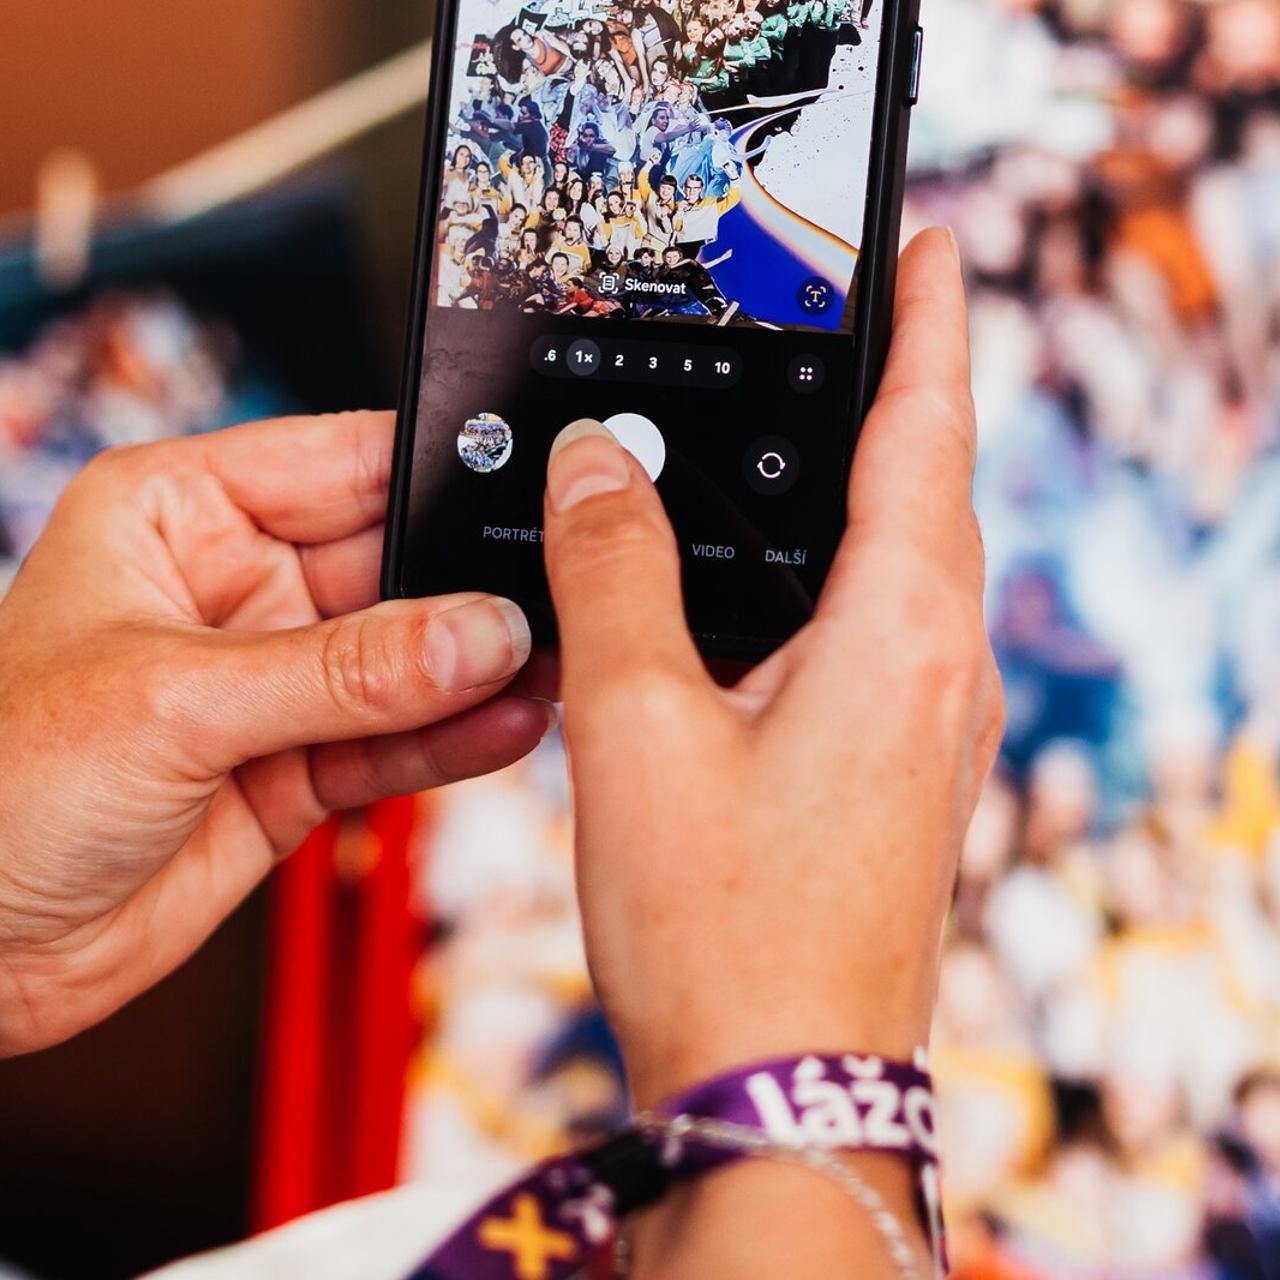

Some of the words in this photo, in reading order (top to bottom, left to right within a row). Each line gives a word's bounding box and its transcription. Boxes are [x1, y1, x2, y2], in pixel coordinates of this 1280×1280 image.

[624, 278, 686, 295] Skenovat
[544, 349, 557, 361] .6
[575, 350, 593, 363] 1x
[615, 354, 624, 366] 2
[648, 357, 658, 369] 3
[683, 359, 693, 371] 5
[714, 361, 731, 374] 10
[692, 543, 736, 559] VIDEO
[765, 549, 808, 565] DALŠÍ
